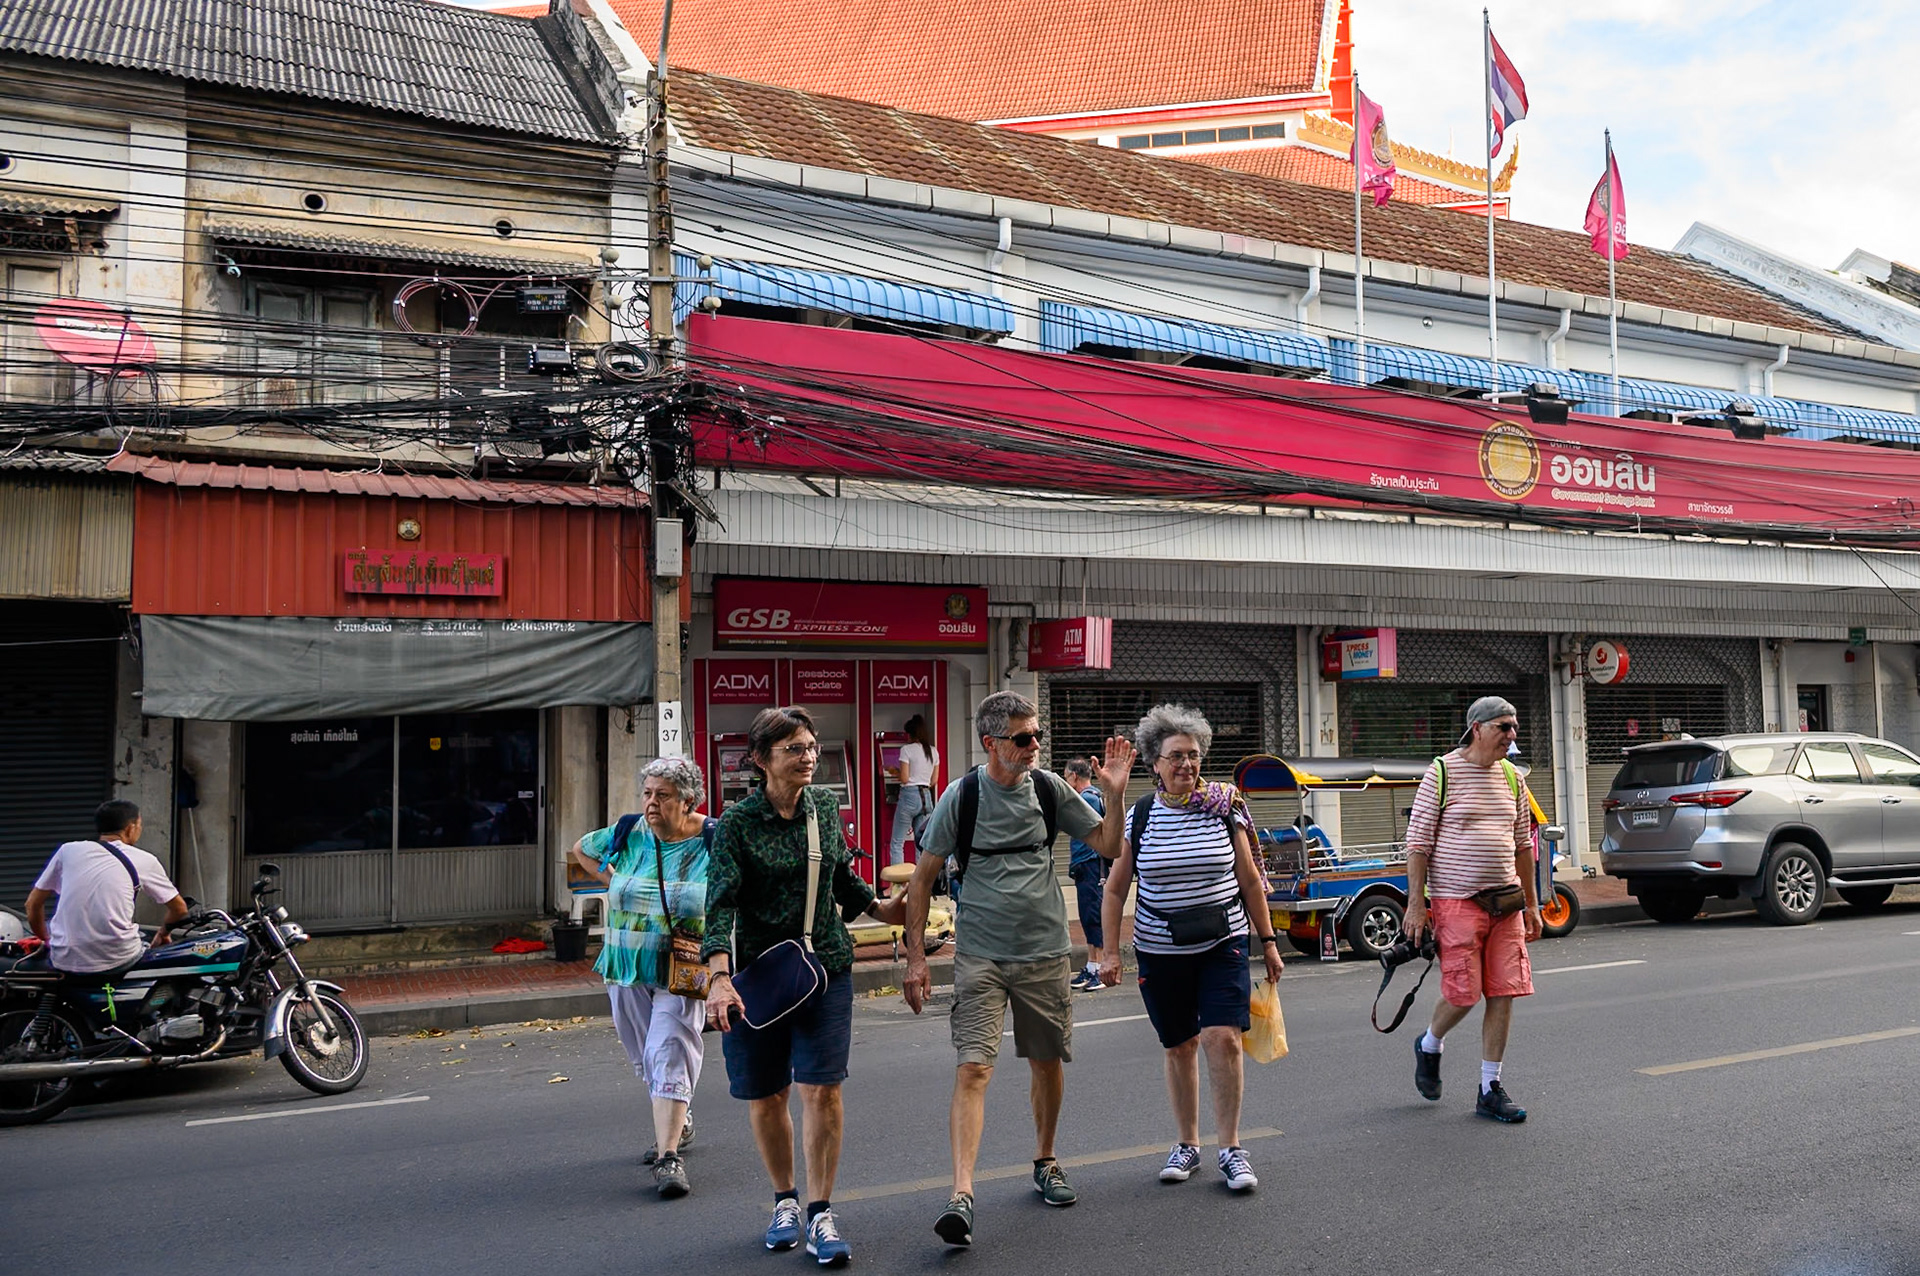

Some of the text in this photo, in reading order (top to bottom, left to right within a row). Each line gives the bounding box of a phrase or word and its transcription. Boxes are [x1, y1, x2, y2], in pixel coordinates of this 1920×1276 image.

[1550, 453, 1656, 493] ออมสิน
[727, 608, 792, 630] GSB
[793, 624, 889, 633] EXPRESS ZONE
[938, 622, 976, 634] ออมสิน
[1064, 628, 1083, 646] ATM
[797, 669, 849, 680] passbook
[713, 674, 770, 690] ADM
[804, 680, 842, 691] update
[877, 674, 929, 690] ADM
[662, 729, 679, 742] 37
